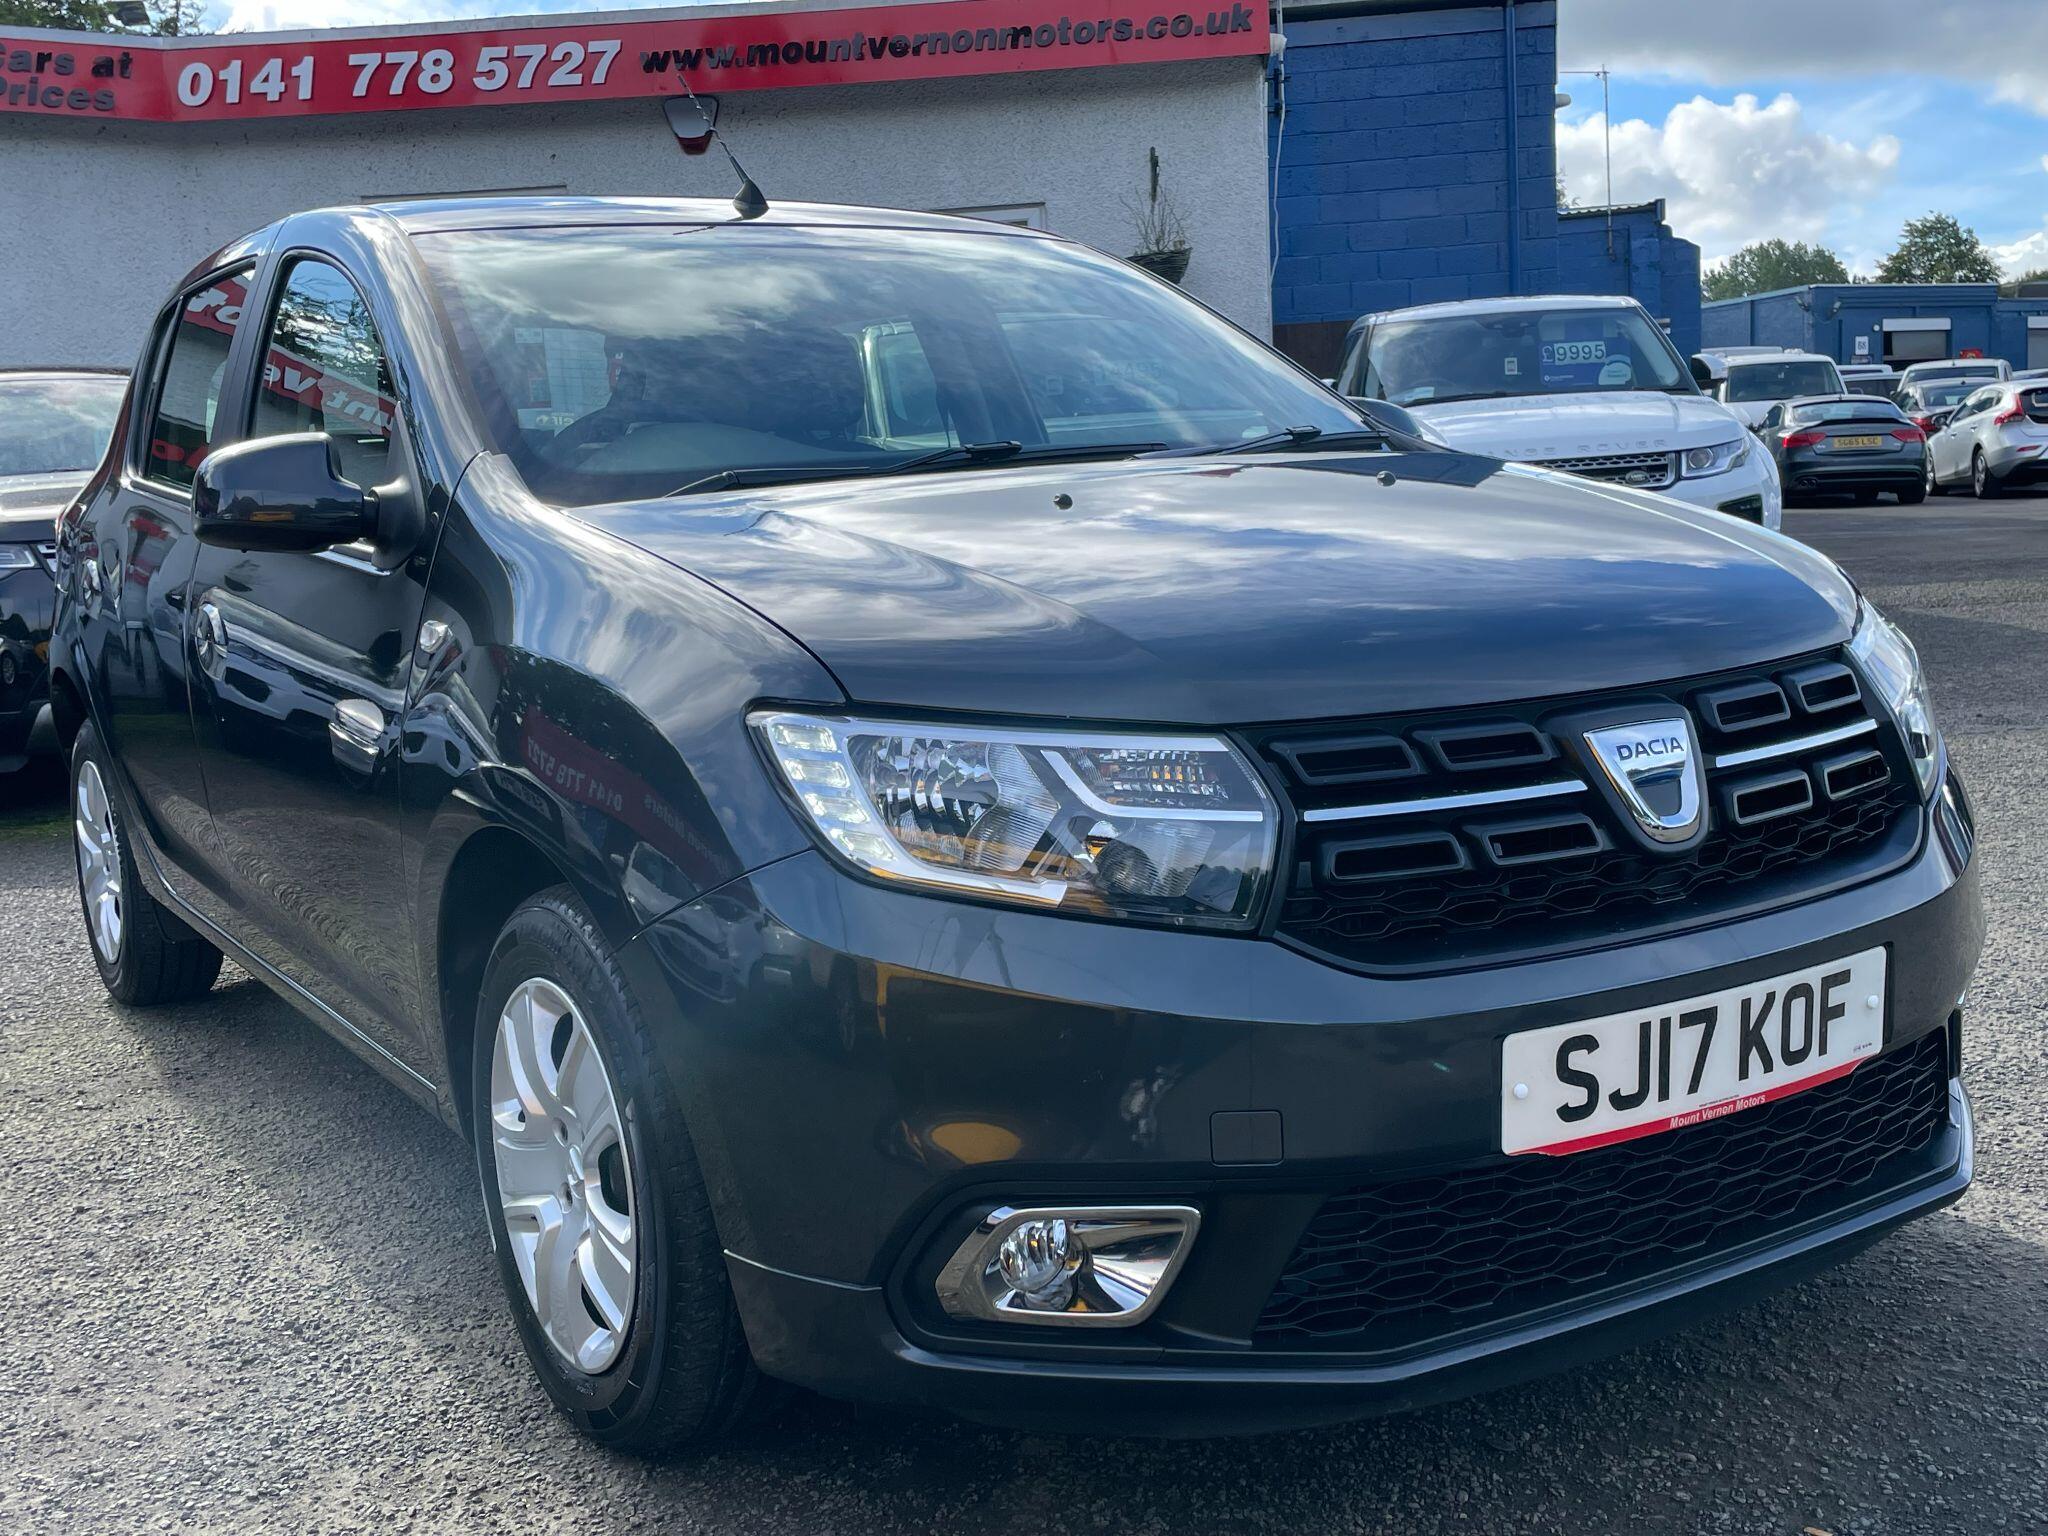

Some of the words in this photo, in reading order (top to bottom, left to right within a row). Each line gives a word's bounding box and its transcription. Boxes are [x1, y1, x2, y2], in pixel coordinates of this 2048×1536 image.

[0, 42, 75, 76] ars
[91, 51, 133, 79] at
[640, 2, 1253, 74] www.mountvernonmotors.co.uk
[178, 55, 315, 108] 0141
[348, 50, 454, 98] 778
[473, 40, 622, 91] 5727
[1615, 736, 1684, 761] DACIA
[1555, 1006, 1718, 1123] SJ17
[1738, 968, 1851, 1081] KOF
[1669, 1111, 1700, 1129] Mount
[1702, 1104, 1733, 1120] Vernon
[1733, 1094, 1766, 1111] Motors
